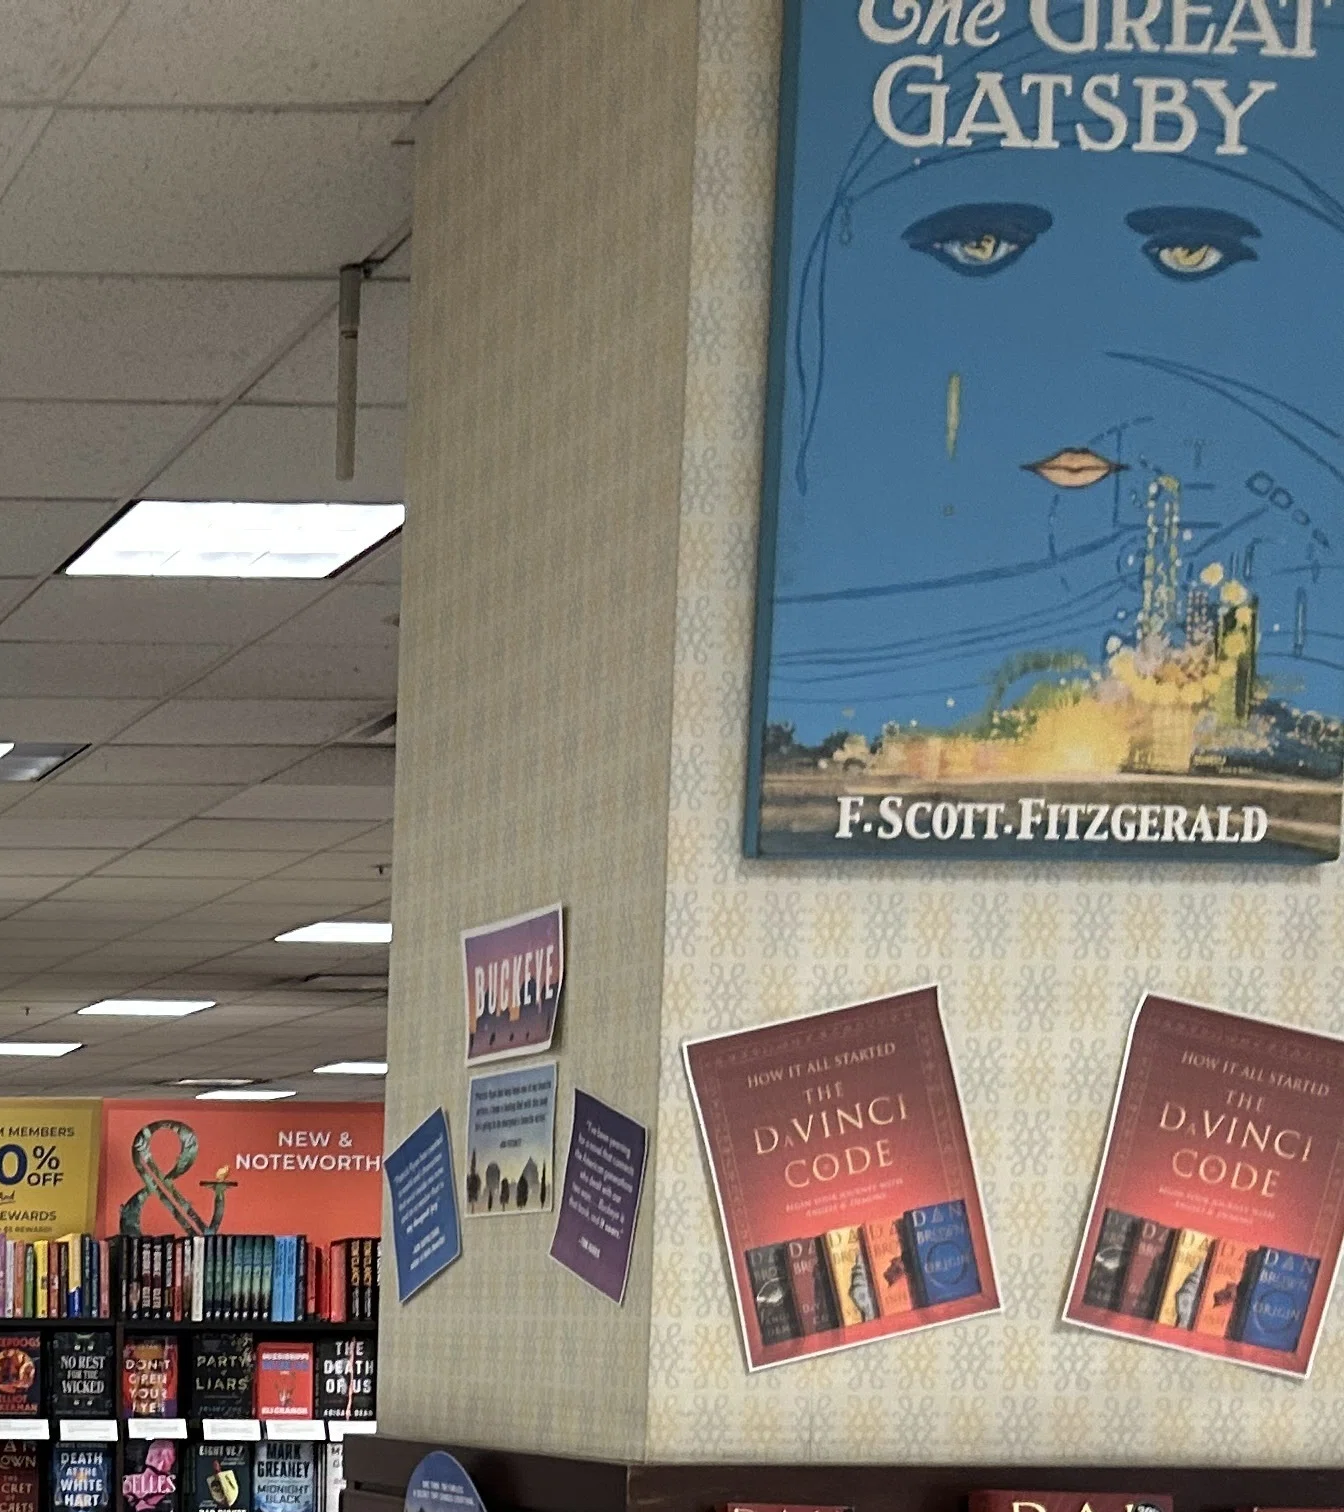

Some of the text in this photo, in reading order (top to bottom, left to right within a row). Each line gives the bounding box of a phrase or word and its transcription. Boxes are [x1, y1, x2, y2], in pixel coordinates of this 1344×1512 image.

[859, 0, 1330, 58] The GREAT
[873, 54, 1278, 155] GATSBY
[1017, 799, 1268, 843] FITZGERALD
[475, 944, 554, 1018] BUCKEYE
[748, 1042, 896, 1088] HOW IT ALL STARTED
[804, 1081, 844, 1104] THE
[9, 1126, 74, 1137] MEMBERS
[278, 1130, 353, 1147] NEW &
[236, 1153, 381, 1171] NOTEWORTH
[784, 1139, 893, 1188] CODE
[28, 1174, 63, 1187] OFF
[1172, 1148, 1281, 1198] CODE
[62, 1356, 105, 1369] NO REST
[324, 1360, 374, 1375] DEATH
[62, 1380, 104, 1394] WICKED
[62, 1452, 103, 1466] DEATH
[266, 1442, 301, 1460] MARK
[258, 1462, 311, 1478] GREANEY
[61, 1479, 103, 1492] WHITE
